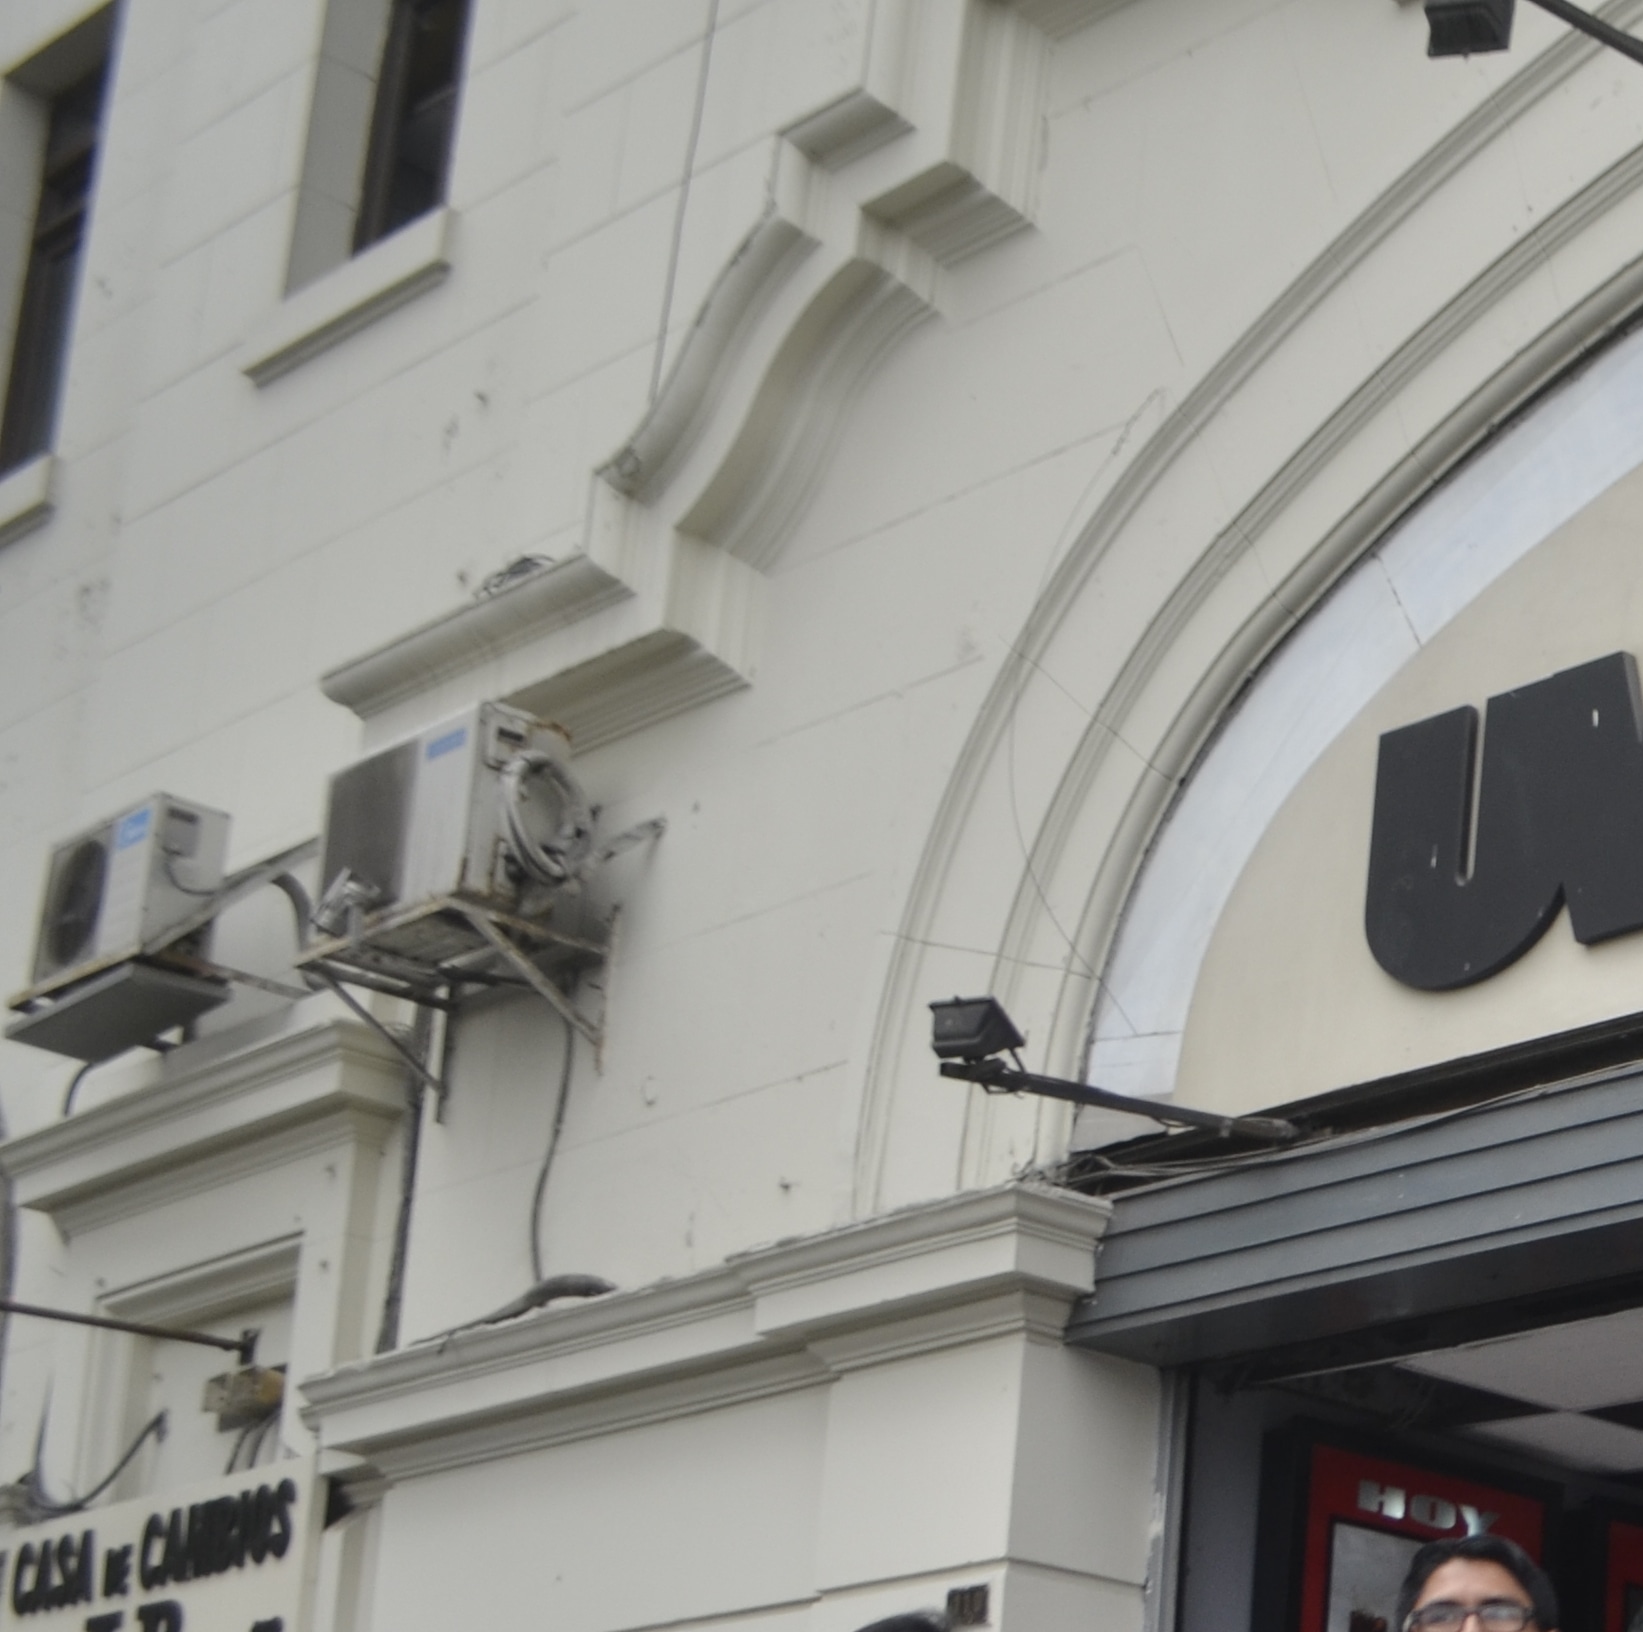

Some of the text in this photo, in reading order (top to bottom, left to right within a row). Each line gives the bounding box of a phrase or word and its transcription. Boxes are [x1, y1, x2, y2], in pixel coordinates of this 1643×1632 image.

[1356, 1478, 1501, 1537] HOY
[13, 1528, 95, 1617] CASA
[104, 1543, 132, 1598] DE
